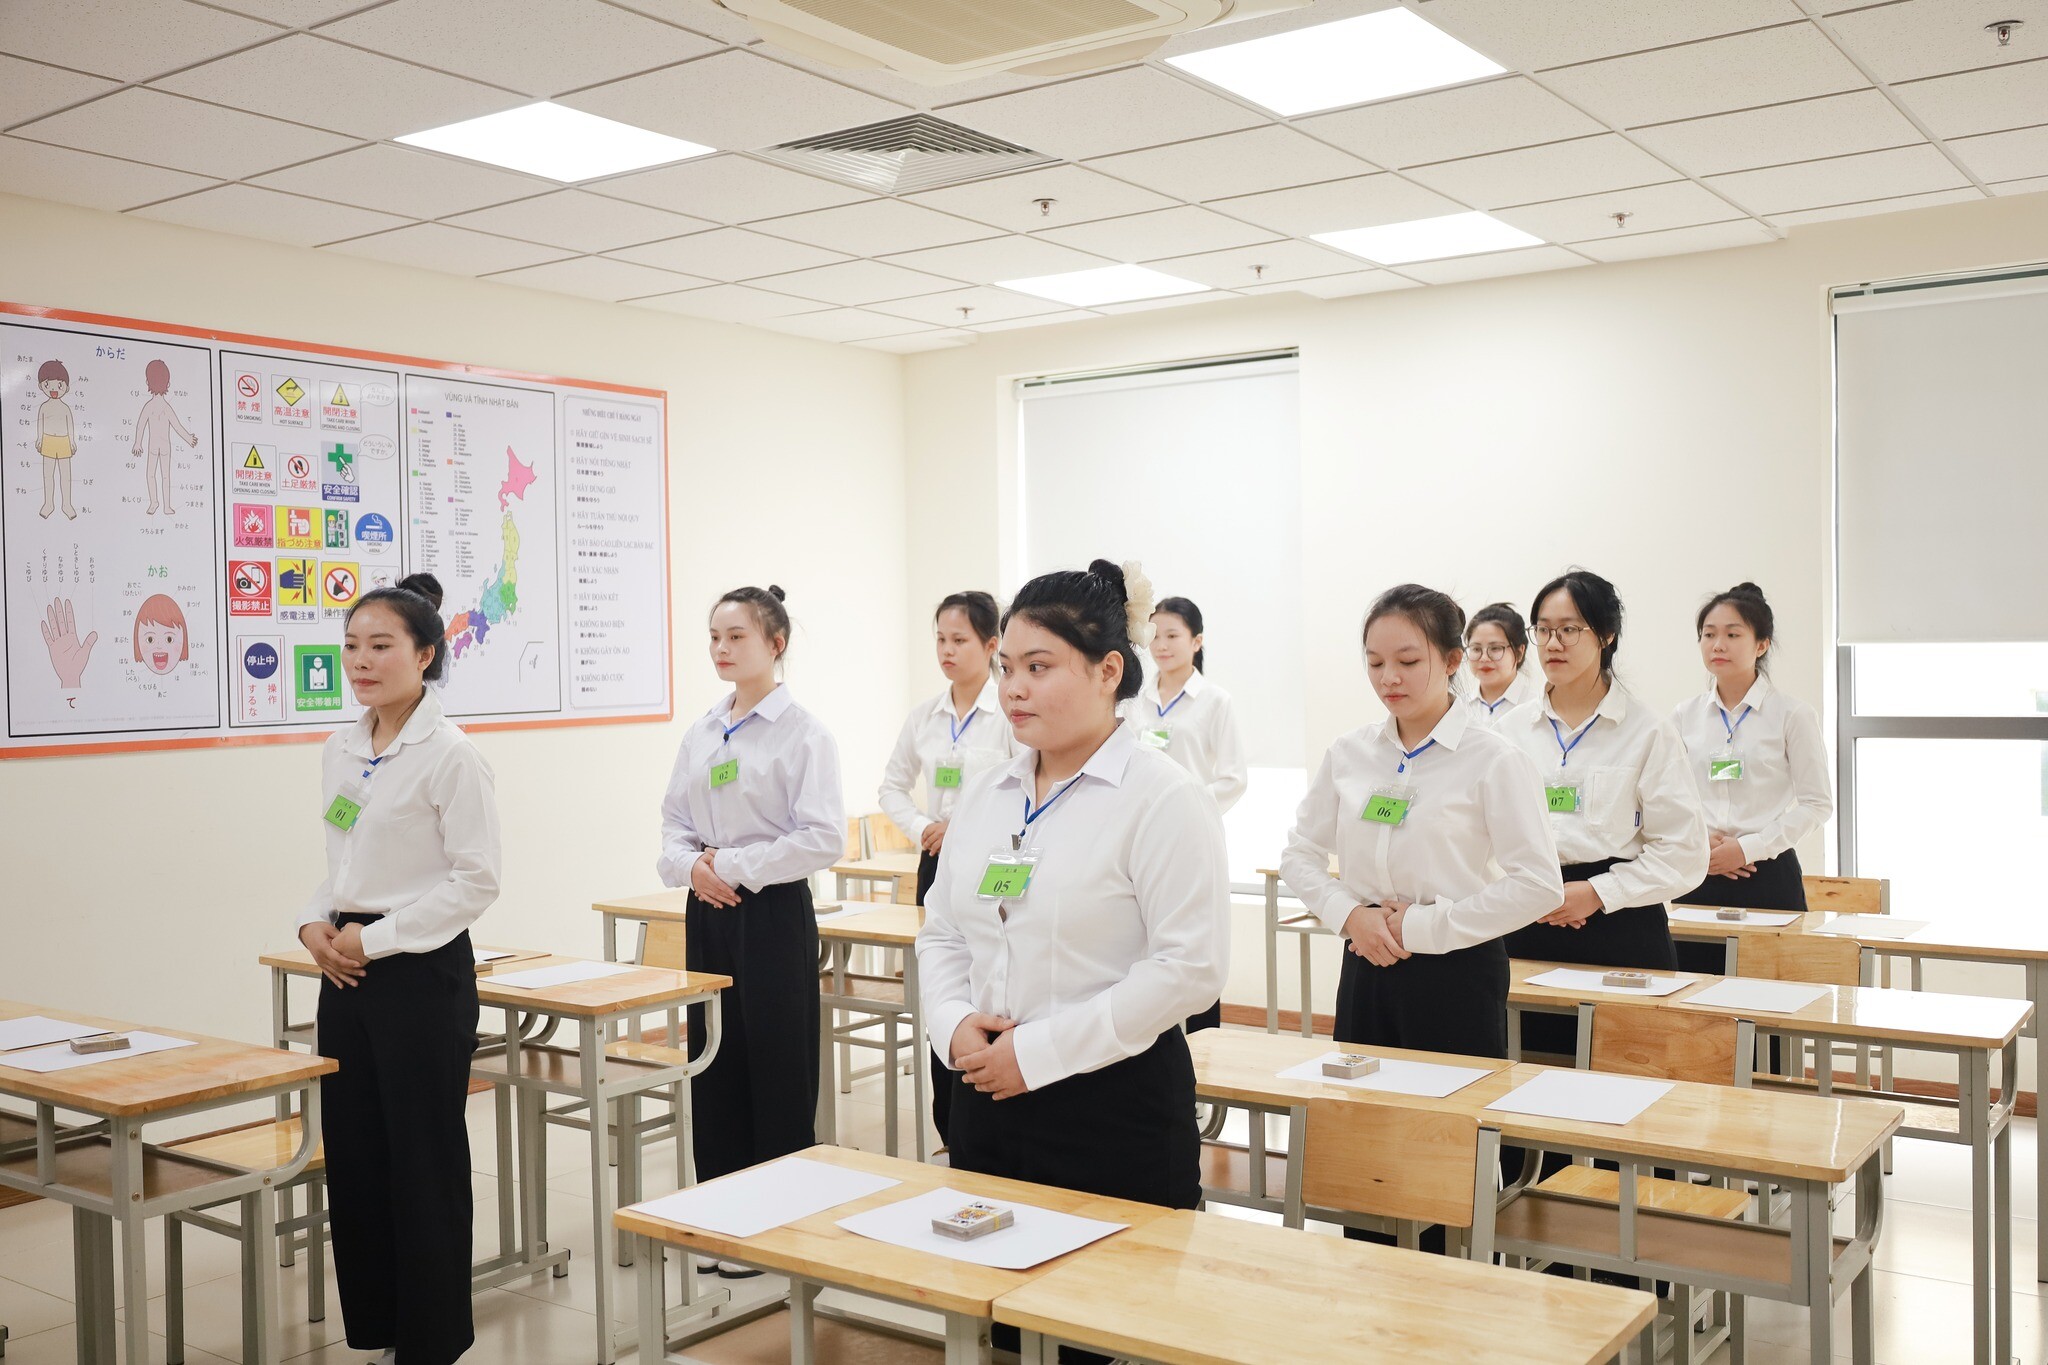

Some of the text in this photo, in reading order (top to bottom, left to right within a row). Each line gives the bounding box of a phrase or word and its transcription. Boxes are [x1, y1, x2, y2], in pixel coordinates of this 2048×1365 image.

[95, 345, 126, 360] からだ
[75, 404, 85, 412] かた
[274, 405, 310, 419] 高温注意
[322, 406, 358, 418] 開閉注意
[115, 434, 130, 442] てくび
[235, 469, 272, 481] 開閉注意
[282, 478, 317, 490] 土足厳禁
[323, 484, 358, 496] 安全確認
[236, 536, 272, 547] 火気厳禁
[277, 538, 321, 548] 指づめ注意
[147, 565, 168, 578] かお
[231, 599, 270, 612] 撮影禁止
[279, 611, 316, 621] 感電注意
[246, 655, 275, 666] 停止中
[248, 683, 258, 717] するな
[267, 683, 277, 705] 操作
[66, 697, 76, 709] て
[296, 696, 341, 708] 安全帯着用
[719, 770, 729, 781] 02
[942, 775, 952, 783] 03
[1550, 796, 1564, 806] 07
[335, 808, 347, 822] 01
[1377, 806, 1391, 818] 06
[993, 880, 1012, 893] 05
